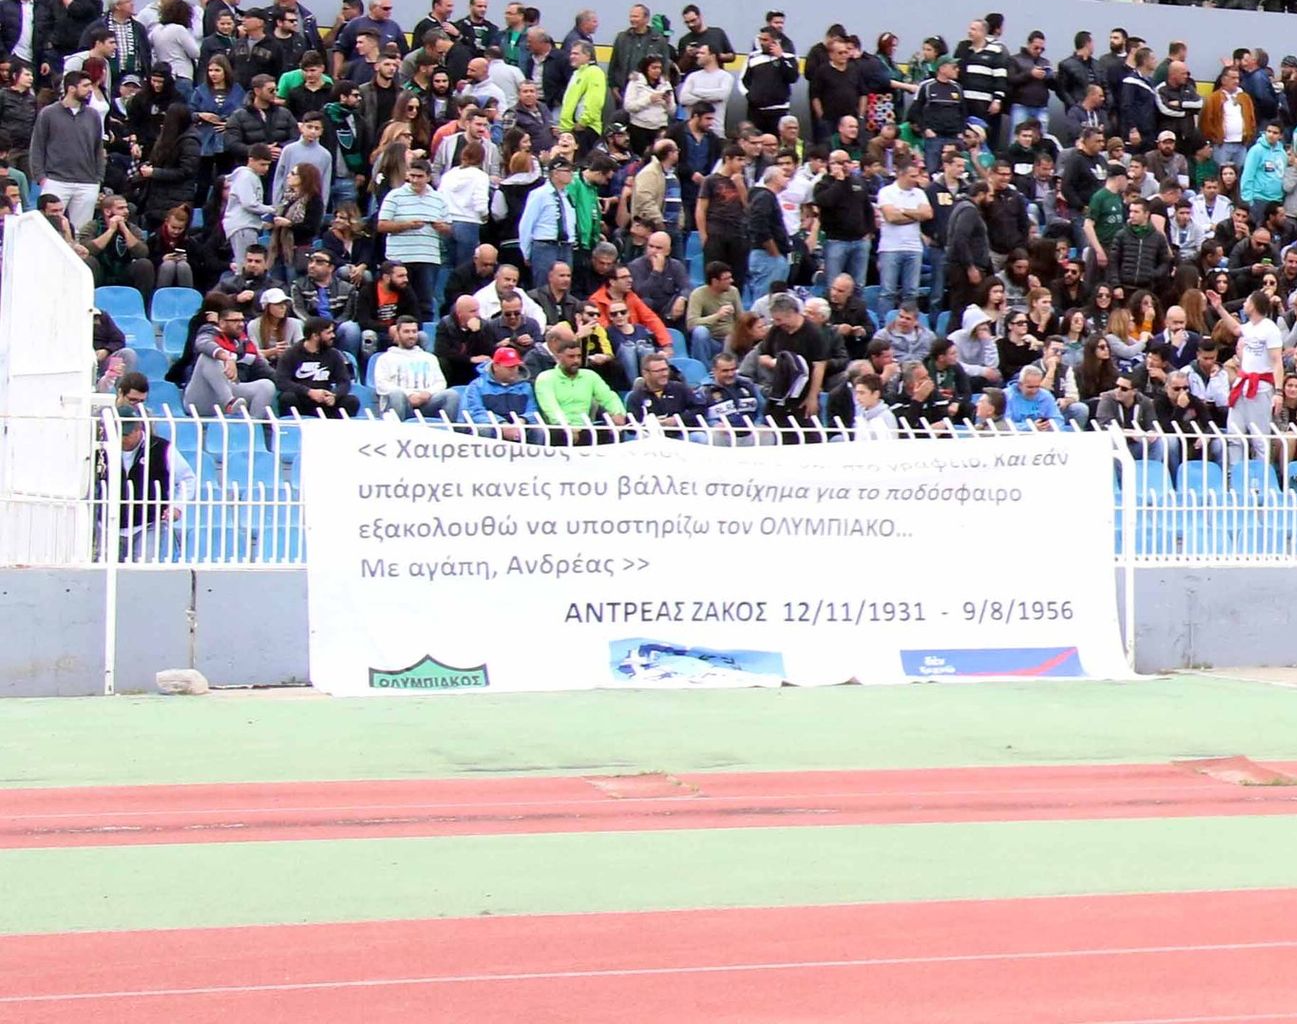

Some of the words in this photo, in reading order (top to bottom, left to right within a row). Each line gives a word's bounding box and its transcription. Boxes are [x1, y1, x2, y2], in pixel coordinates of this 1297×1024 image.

[1032, 447, 1068, 466] εάν
[358, 477, 463, 503] υπάρχει
[472, 476, 551, 500] κανείς
[560, 481, 608, 496] που
[618, 475, 697, 500] βάλλει
[705, 478, 809, 502] στοίχημα
[815, 487, 851, 503] για
[857, 487, 880, 500] το
[885, 483, 1022, 506] ποδόσφαιρο
[358, 514, 518, 543] εξακολουθώ
[527, 519, 558, 535] να
[566, 513, 710, 539] υποστηρίζω
[717, 519, 753, 535] τον
[760, 517, 913, 537] ΟΛΥΜΠΙΑΚΟ...
[361, 559, 400, 578] Με
[408, 555, 498, 581] αγάπη,
[506, 553, 614, 579] Ανδρέας
[564, 601, 685, 623] ΑΝΤΡΕΑΣ
[691, 601, 768, 622] ΖΑΚΟΣ
[782, 599, 926, 626] 12/11/1931
[963, 598, 1074, 624] 9/8/1956
[378, 675, 482, 688] ΟΛΥΜΠΙΑΚΟΣ
